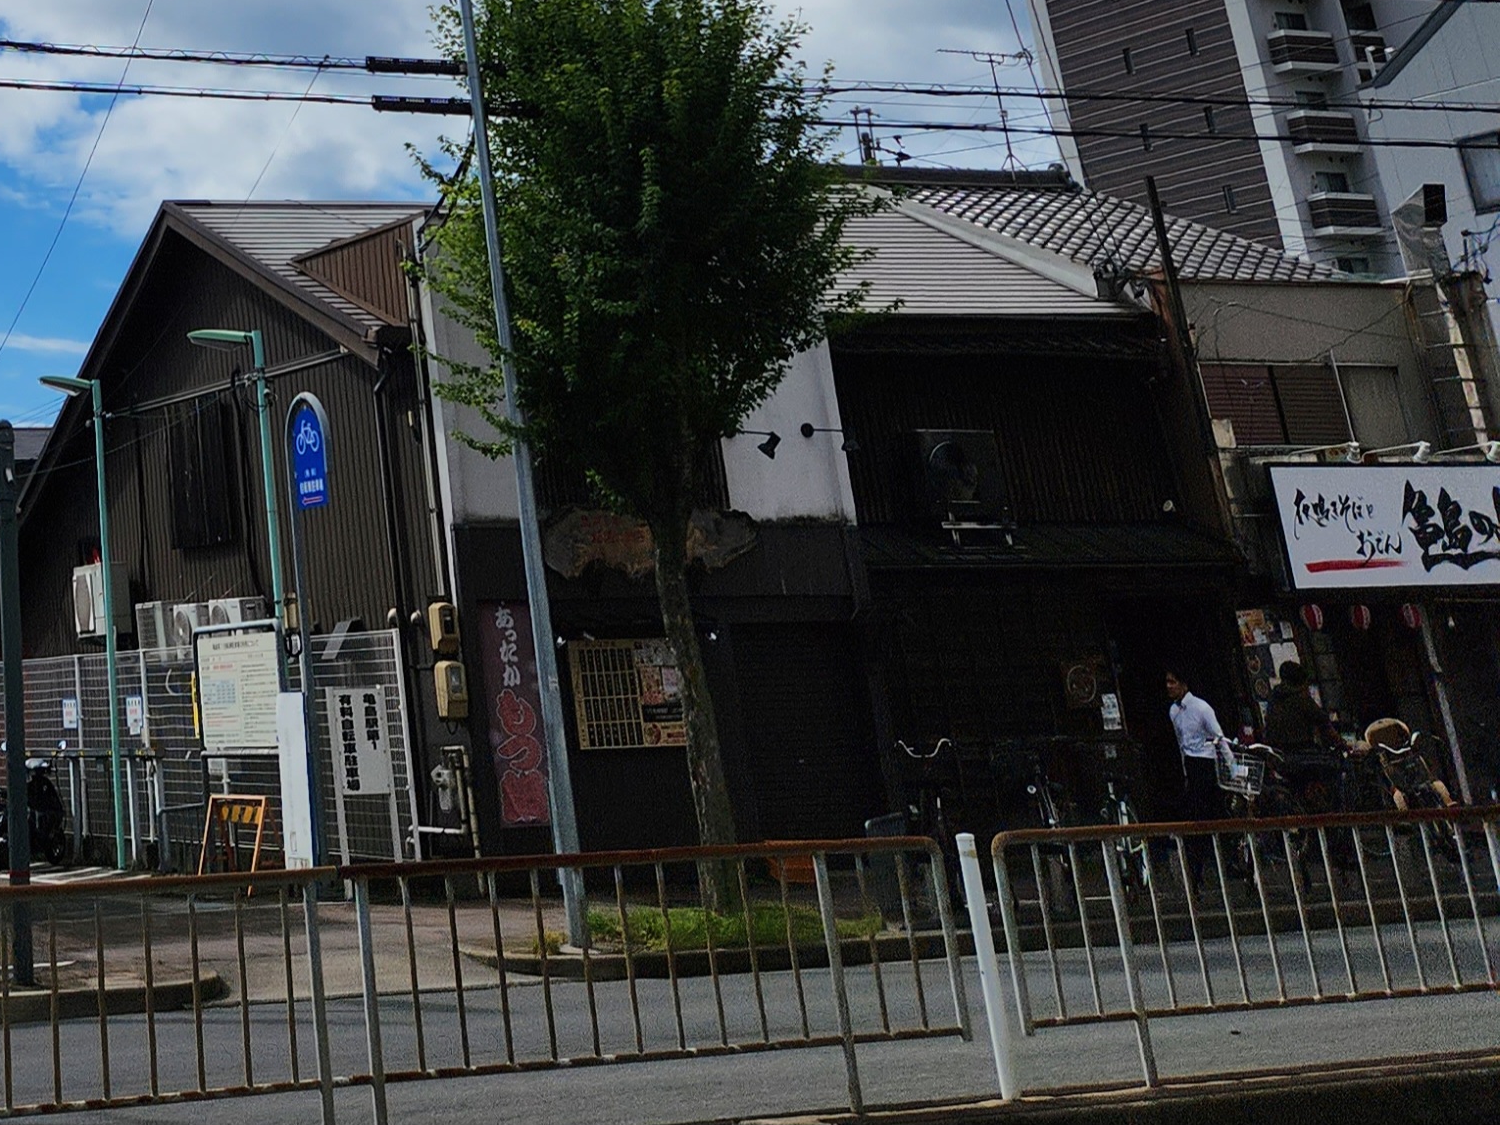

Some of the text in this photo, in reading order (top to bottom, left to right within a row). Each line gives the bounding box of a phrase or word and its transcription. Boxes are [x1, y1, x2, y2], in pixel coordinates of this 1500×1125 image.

[1356, 529, 1402, 567] おでん
[495, 606, 521, 687] あったか
[339, 694, 360, 791] 有料自転車駐車場
[363, 693, 380, 750] 亀島駅第1
